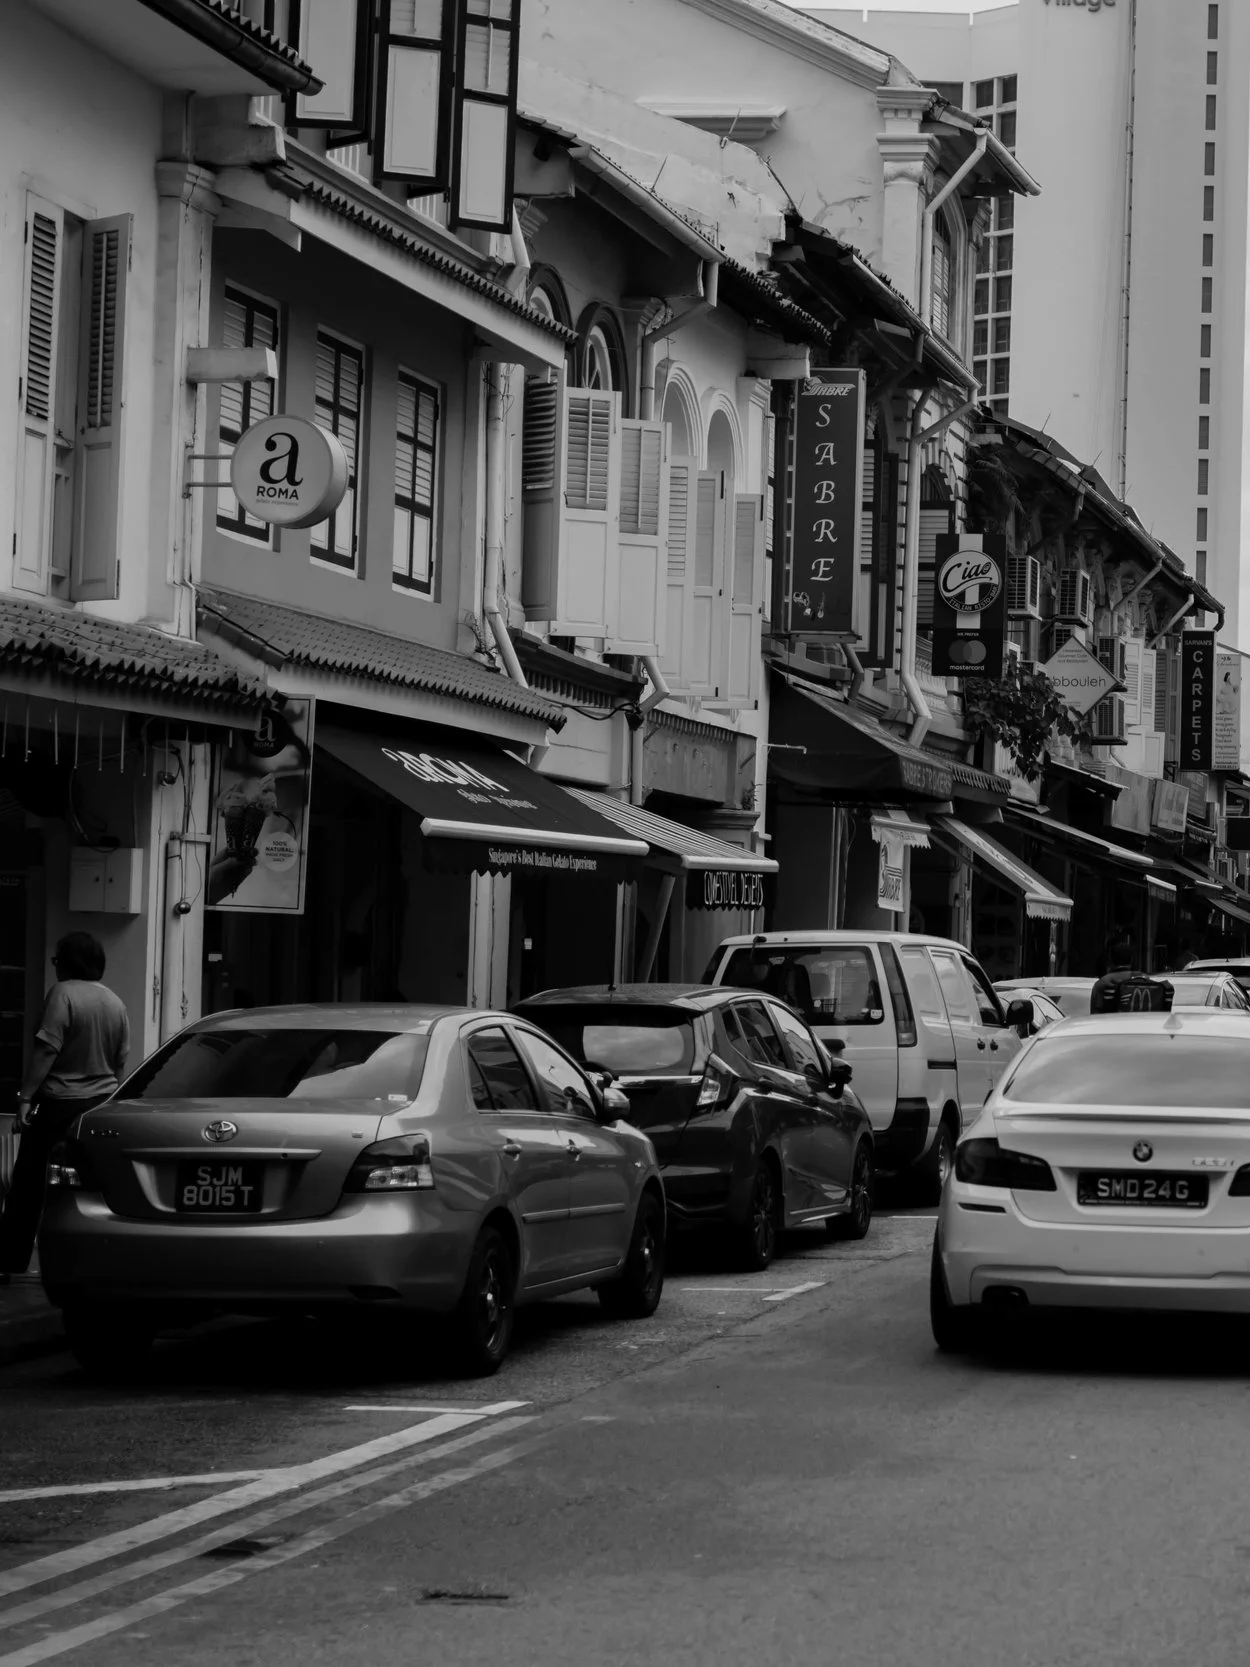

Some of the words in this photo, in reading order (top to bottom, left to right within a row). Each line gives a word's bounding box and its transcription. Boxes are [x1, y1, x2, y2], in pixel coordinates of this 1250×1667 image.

[260, 432, 304, 487] a
[256, 485, 299, 500] ROMA
[811, 403, 838, 581] SABRE
[942, 561, 992, 593] Ciao
[1052, 675, 1107, 688] bbouleh
[1191, 650, 1204, 761] CARPETS
[488, 847, 522, 866] Singapore's
[522, 849, 534, 866] Best
[535, 850, 552, 868] Italian
[552, 853, 569, 869] Gelato
[569, 854, 597, 872] Experience
[197, 1165, 243, 1186] SJM
